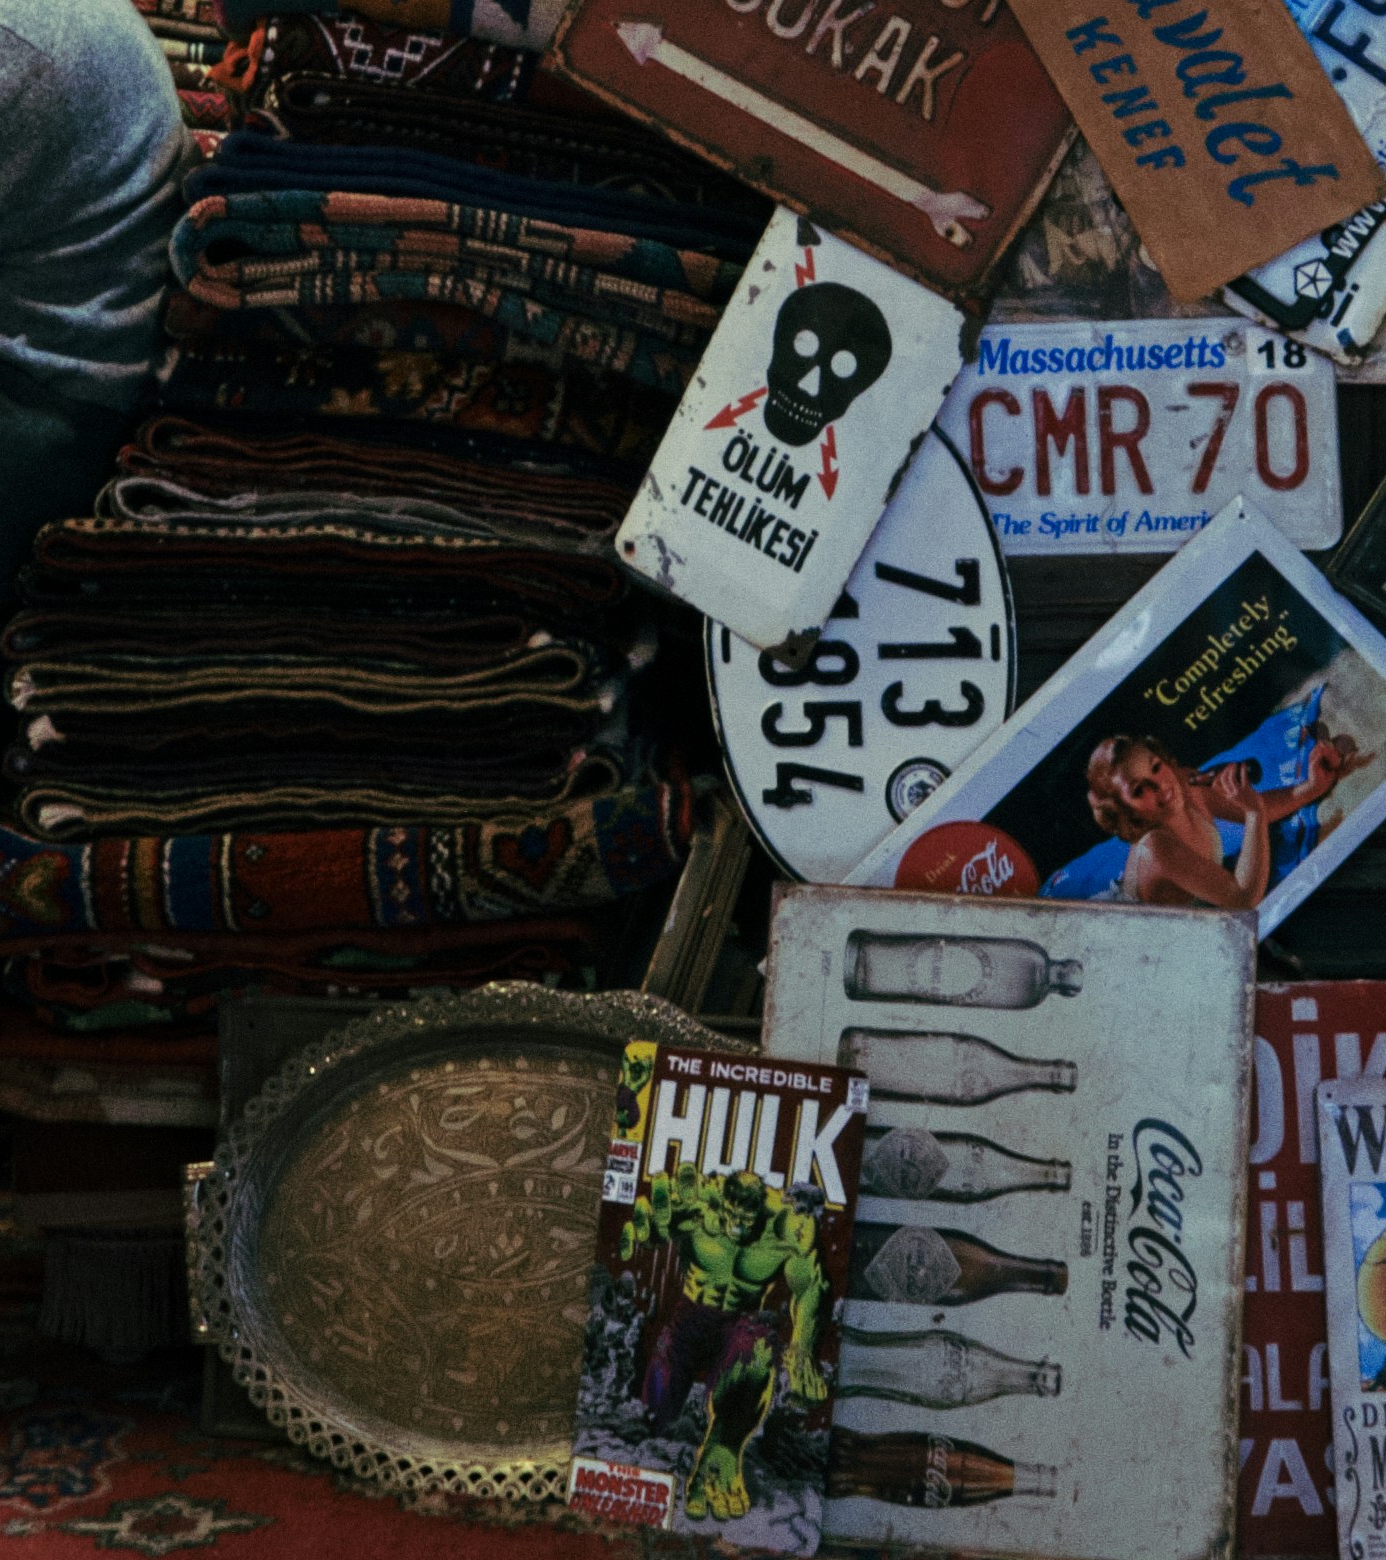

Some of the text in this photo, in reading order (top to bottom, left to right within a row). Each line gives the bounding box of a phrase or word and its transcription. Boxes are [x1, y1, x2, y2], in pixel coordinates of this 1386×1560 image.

[1065, 16, 1188, 174] KENEF
[978, 334, 1308, 376] Massachusetts 18
[722, 428, 812, 511] ÖLÜM
[968, 382, 1311, 498] CMR 70
[682, 467, 820, 575] TEHLİKESİ
[1038, 511, 1100, 540] Spirit
[1106, 511, 1130, 537] of
[1135, 510, 1213, 535] Ameri
[875, 556, 984, 728] 713
[757, 590, 866, 810] 854
[667, 1054, 703, 1077] THE
[710, 1060, 834, 1095] INCREDIBLE
[643, 1080, 857, 1210] HULK
[1093, 1132, 1130, 1331] In the Distinctive Bottle
[575, 1467, 671, 1504] MONSTER
